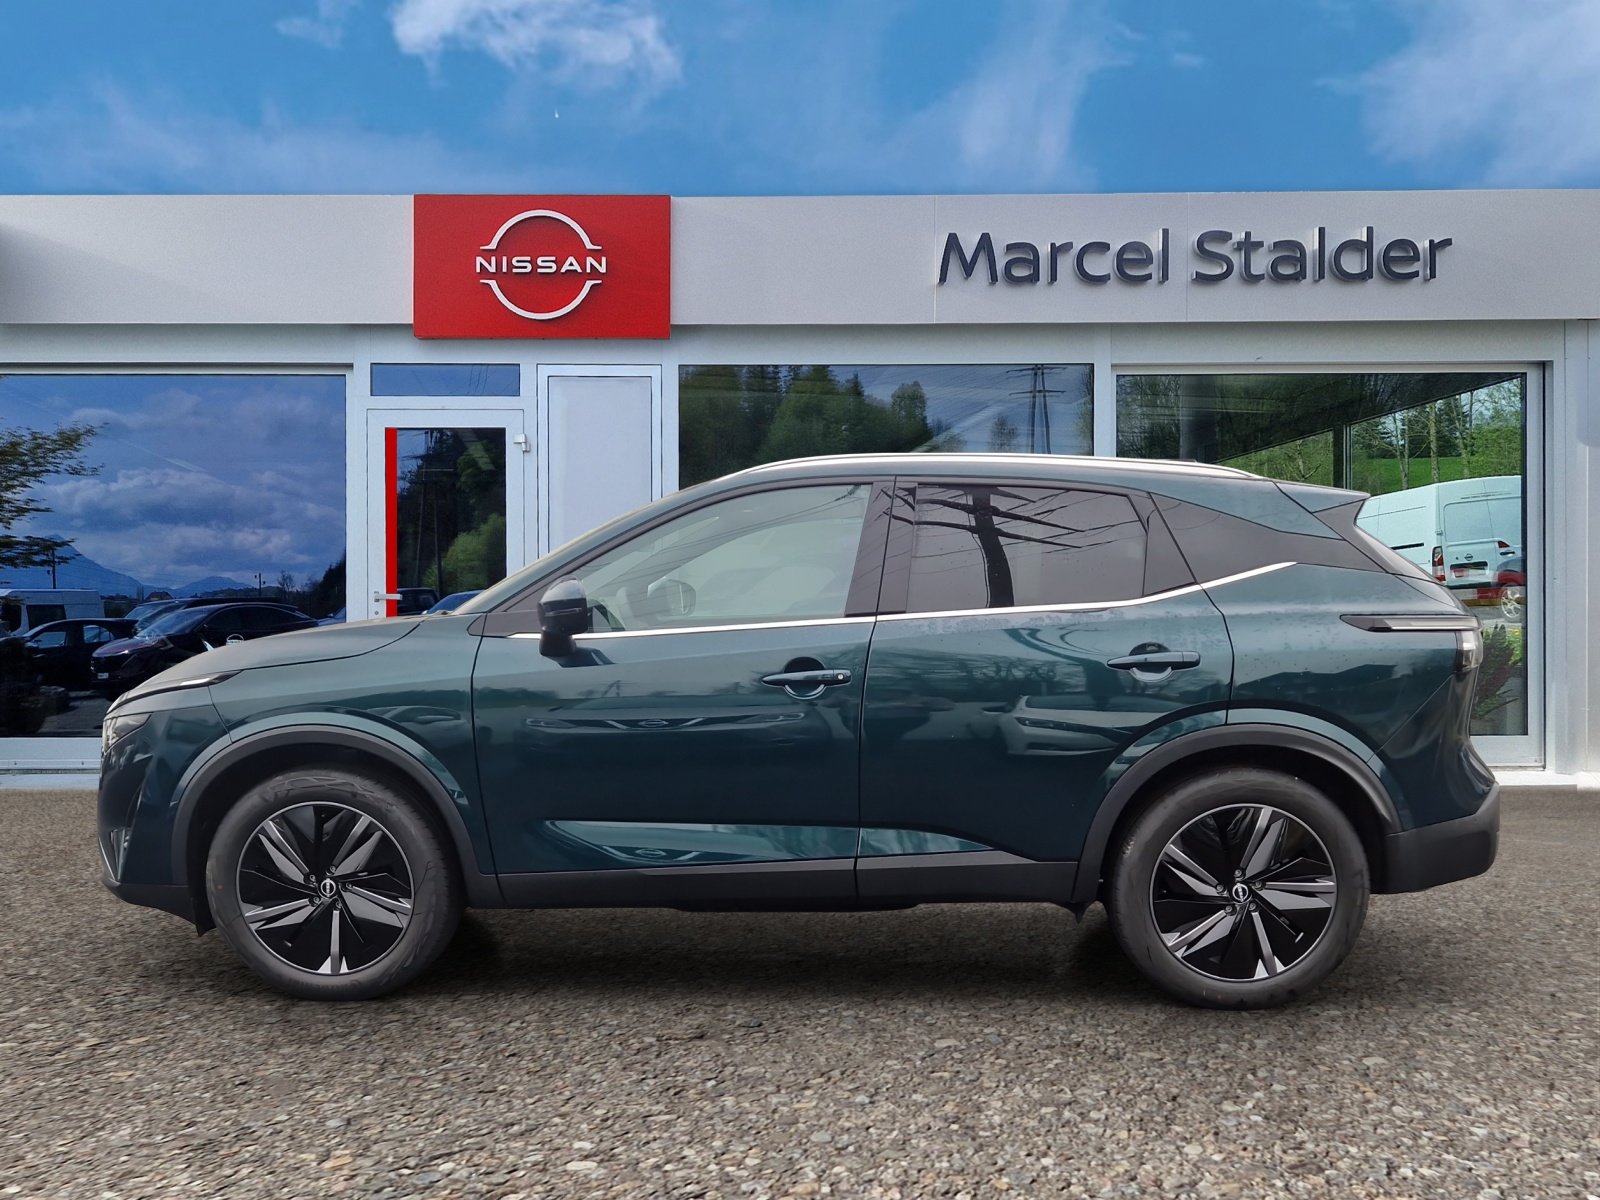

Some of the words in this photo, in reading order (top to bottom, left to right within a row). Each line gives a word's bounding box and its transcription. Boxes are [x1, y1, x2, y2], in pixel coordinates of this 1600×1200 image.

[475, 255, 607, 273] NISSAN
[938, 228, 1170, 285] Marcel
[1191, 226, 1453, 283] Stalder
